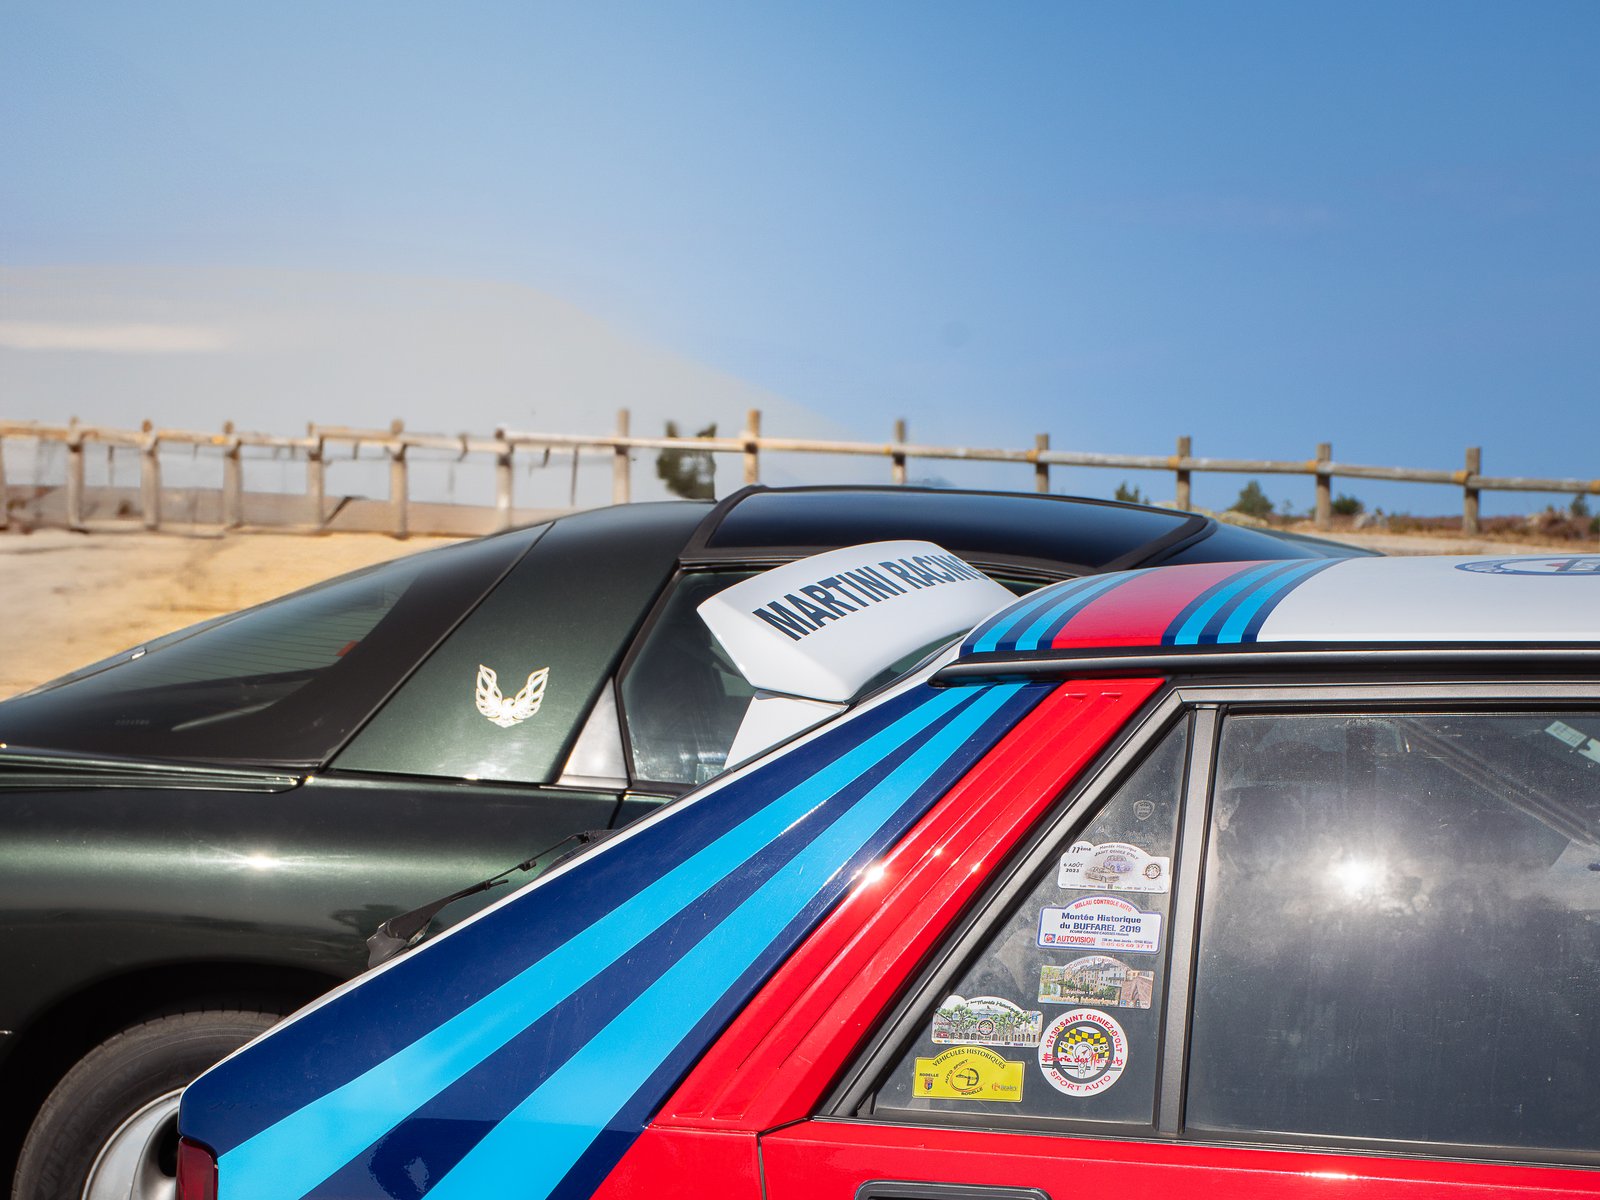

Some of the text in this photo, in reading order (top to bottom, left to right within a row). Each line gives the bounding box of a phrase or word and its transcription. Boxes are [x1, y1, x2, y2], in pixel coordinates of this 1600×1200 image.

[752, 555, 990, 641] MARTINI RACING
[1061, 912, 1141, 923] Montée Historique
[1073, 923, 1116, 931] BUFFAREL
[1120, 925, 1141, 933] 2019
[1057, 935, 1096, 943] AUTOVISION
[1046, 1027, 1060, 1048] 12130
[1060, 1014, 1083, 1027] SAINT
[1086, 1014, 1114, 1031] GENIEZ
[967, 1049, 1006, 1069] HISTORIQUES
[1050, 1070, 1111, 1091] SPORT AUTO
